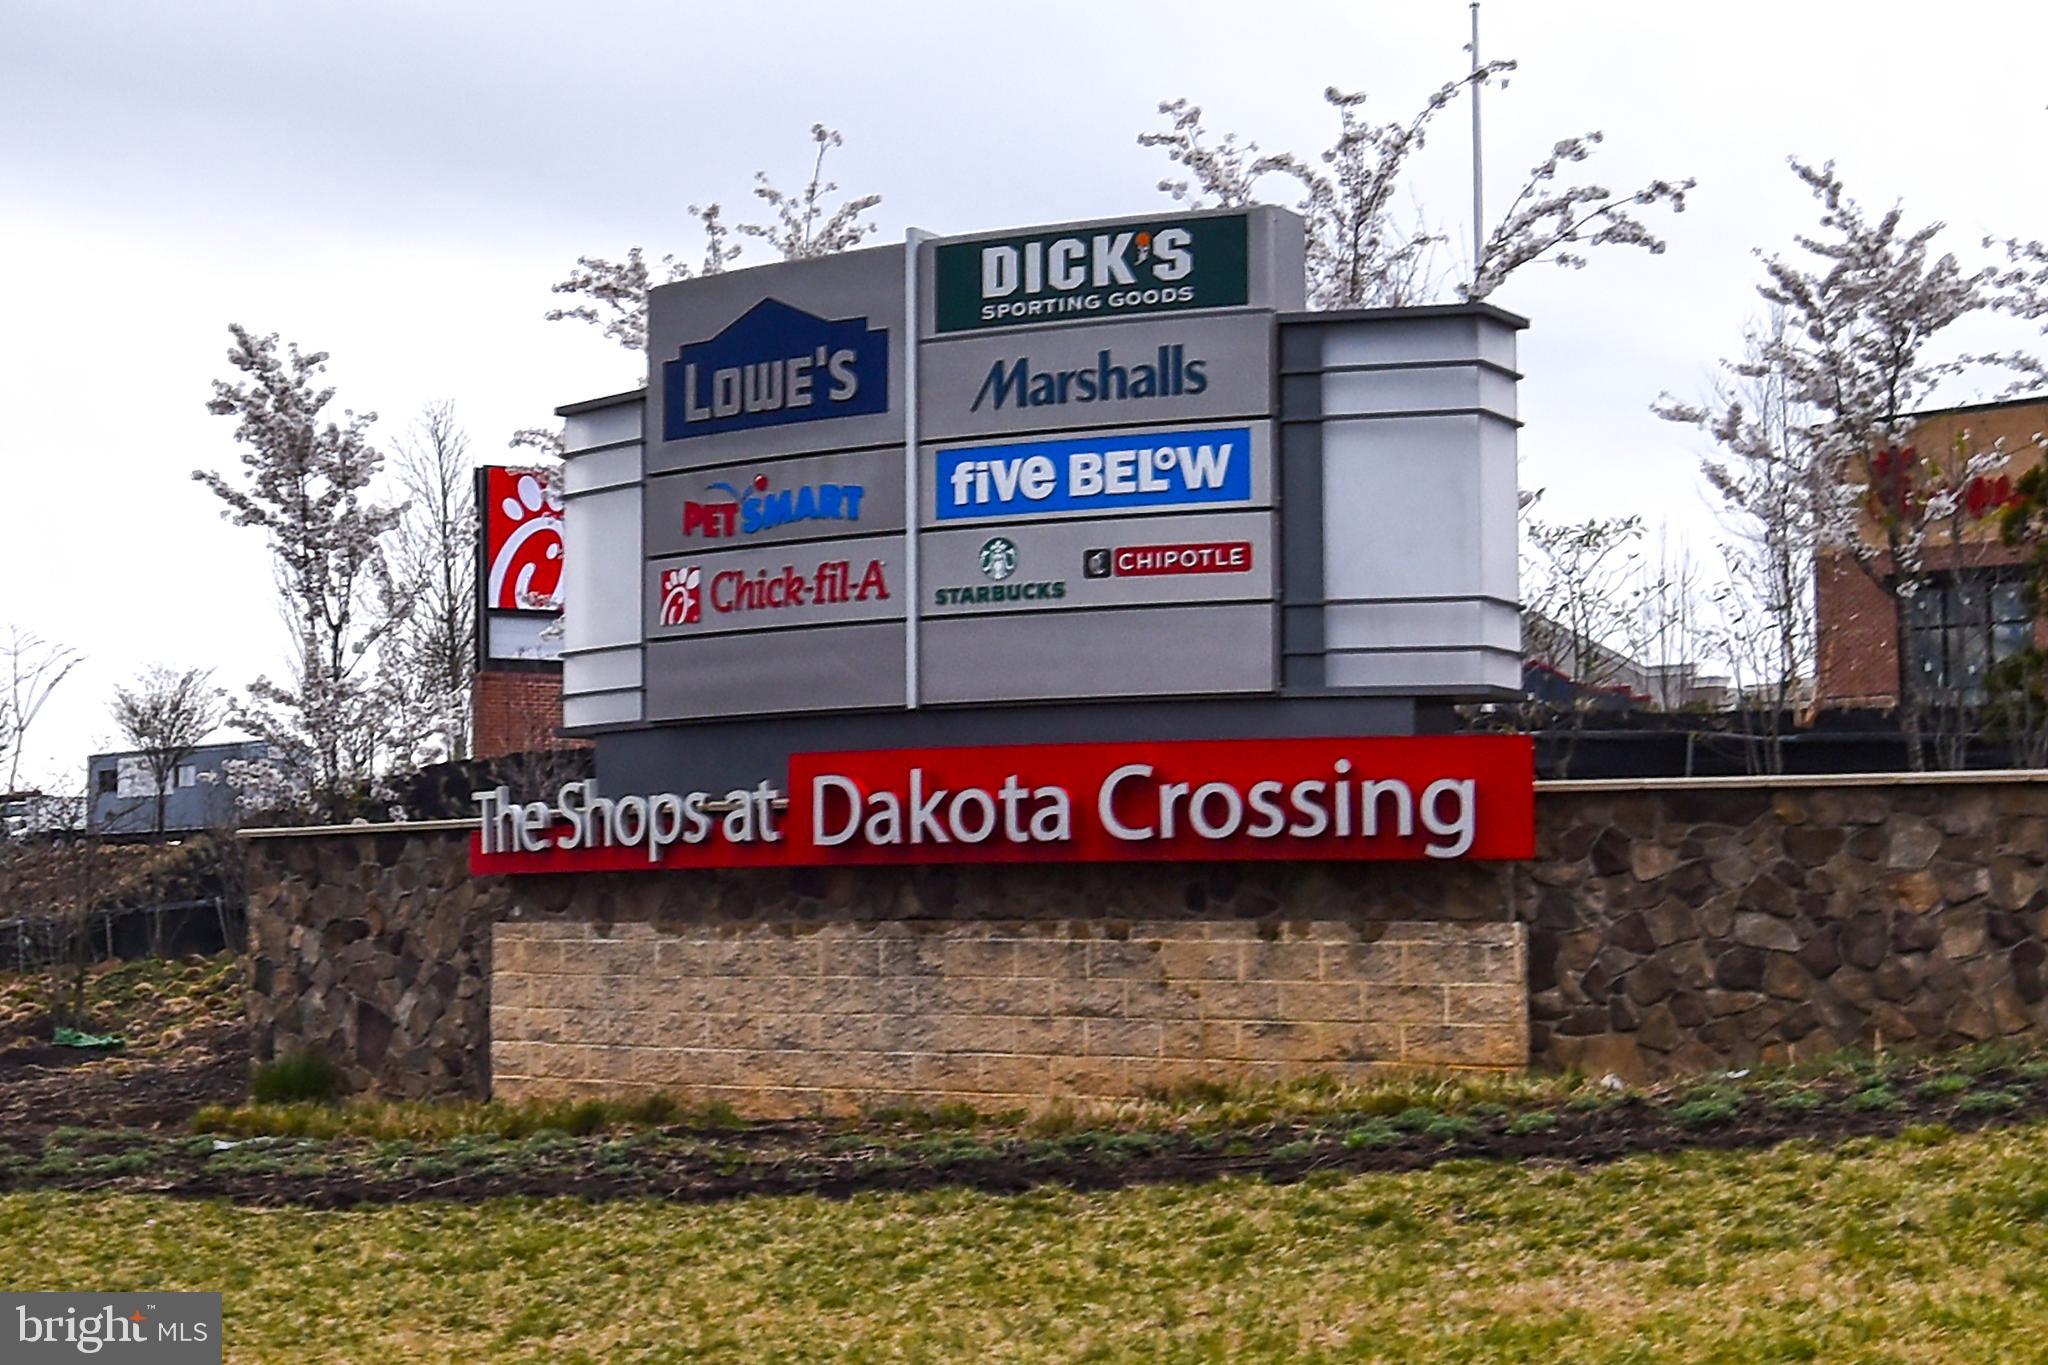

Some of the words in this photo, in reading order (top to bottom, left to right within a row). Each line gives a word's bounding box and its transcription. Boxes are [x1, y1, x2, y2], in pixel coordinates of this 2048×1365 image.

[982, 228, 1194, 299] DICK'S
[980, 294, 1101, 321] SPORTING
[1107, 285, 1196, 310] GOODS
[685, 347, 857, 423] LOWE'S
[970, 344, 1208, 412] Marshalls
[950, 455, 1056, 506] five
[1069, 443, 1233, 498] BELOW
[710, 559, 890, 614] Chick-fil-A
[1117, 546, 1246, 572] CHIPOTLE
[935, 580, 1067, 606] STARBUCKS
[471, 785, 550, 856] The
[556, 777, 710, 863] Shops
[722, 779, 781, 843] at
[812, 769, 1071, 846] Dakota
[1098, 759, 1476, 858] Crossing
